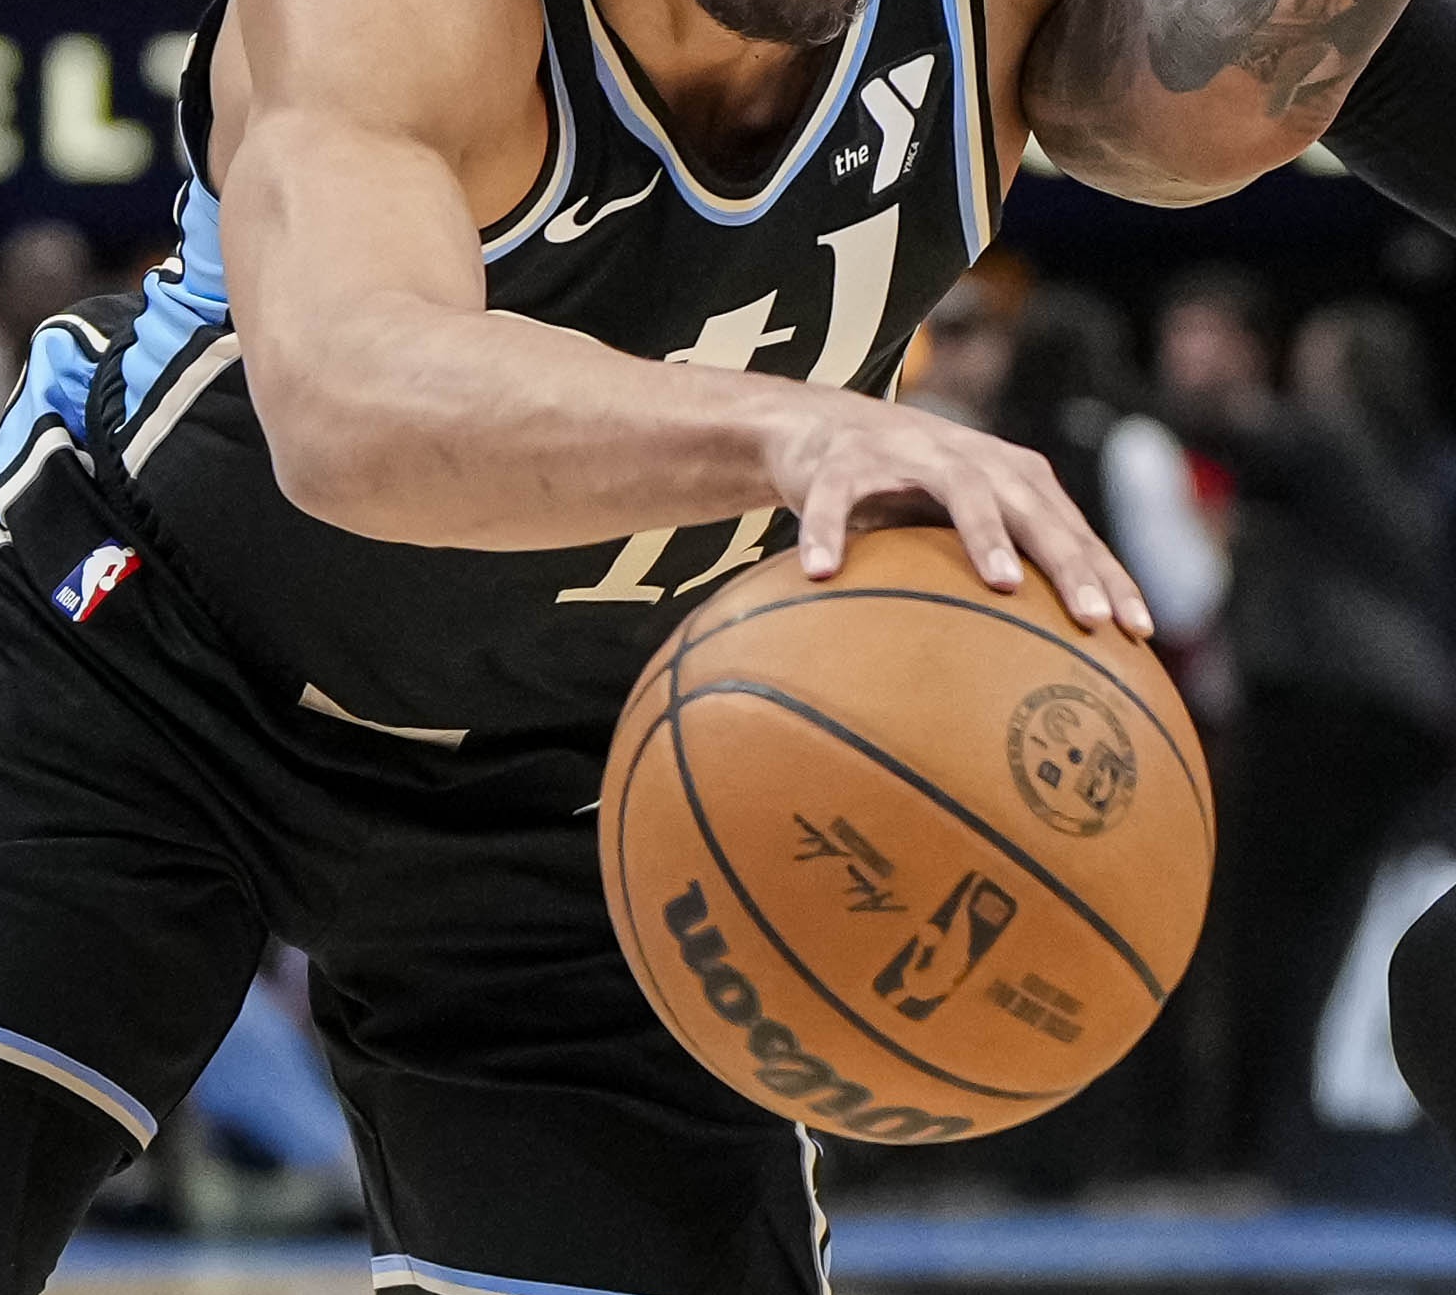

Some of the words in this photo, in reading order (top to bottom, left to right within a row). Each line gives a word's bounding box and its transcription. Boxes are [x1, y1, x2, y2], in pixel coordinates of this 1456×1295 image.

[834, 143, 870, 177] the
[902, 141, 921, 174] YMCA
[55, 585, 82, 612] NBA
